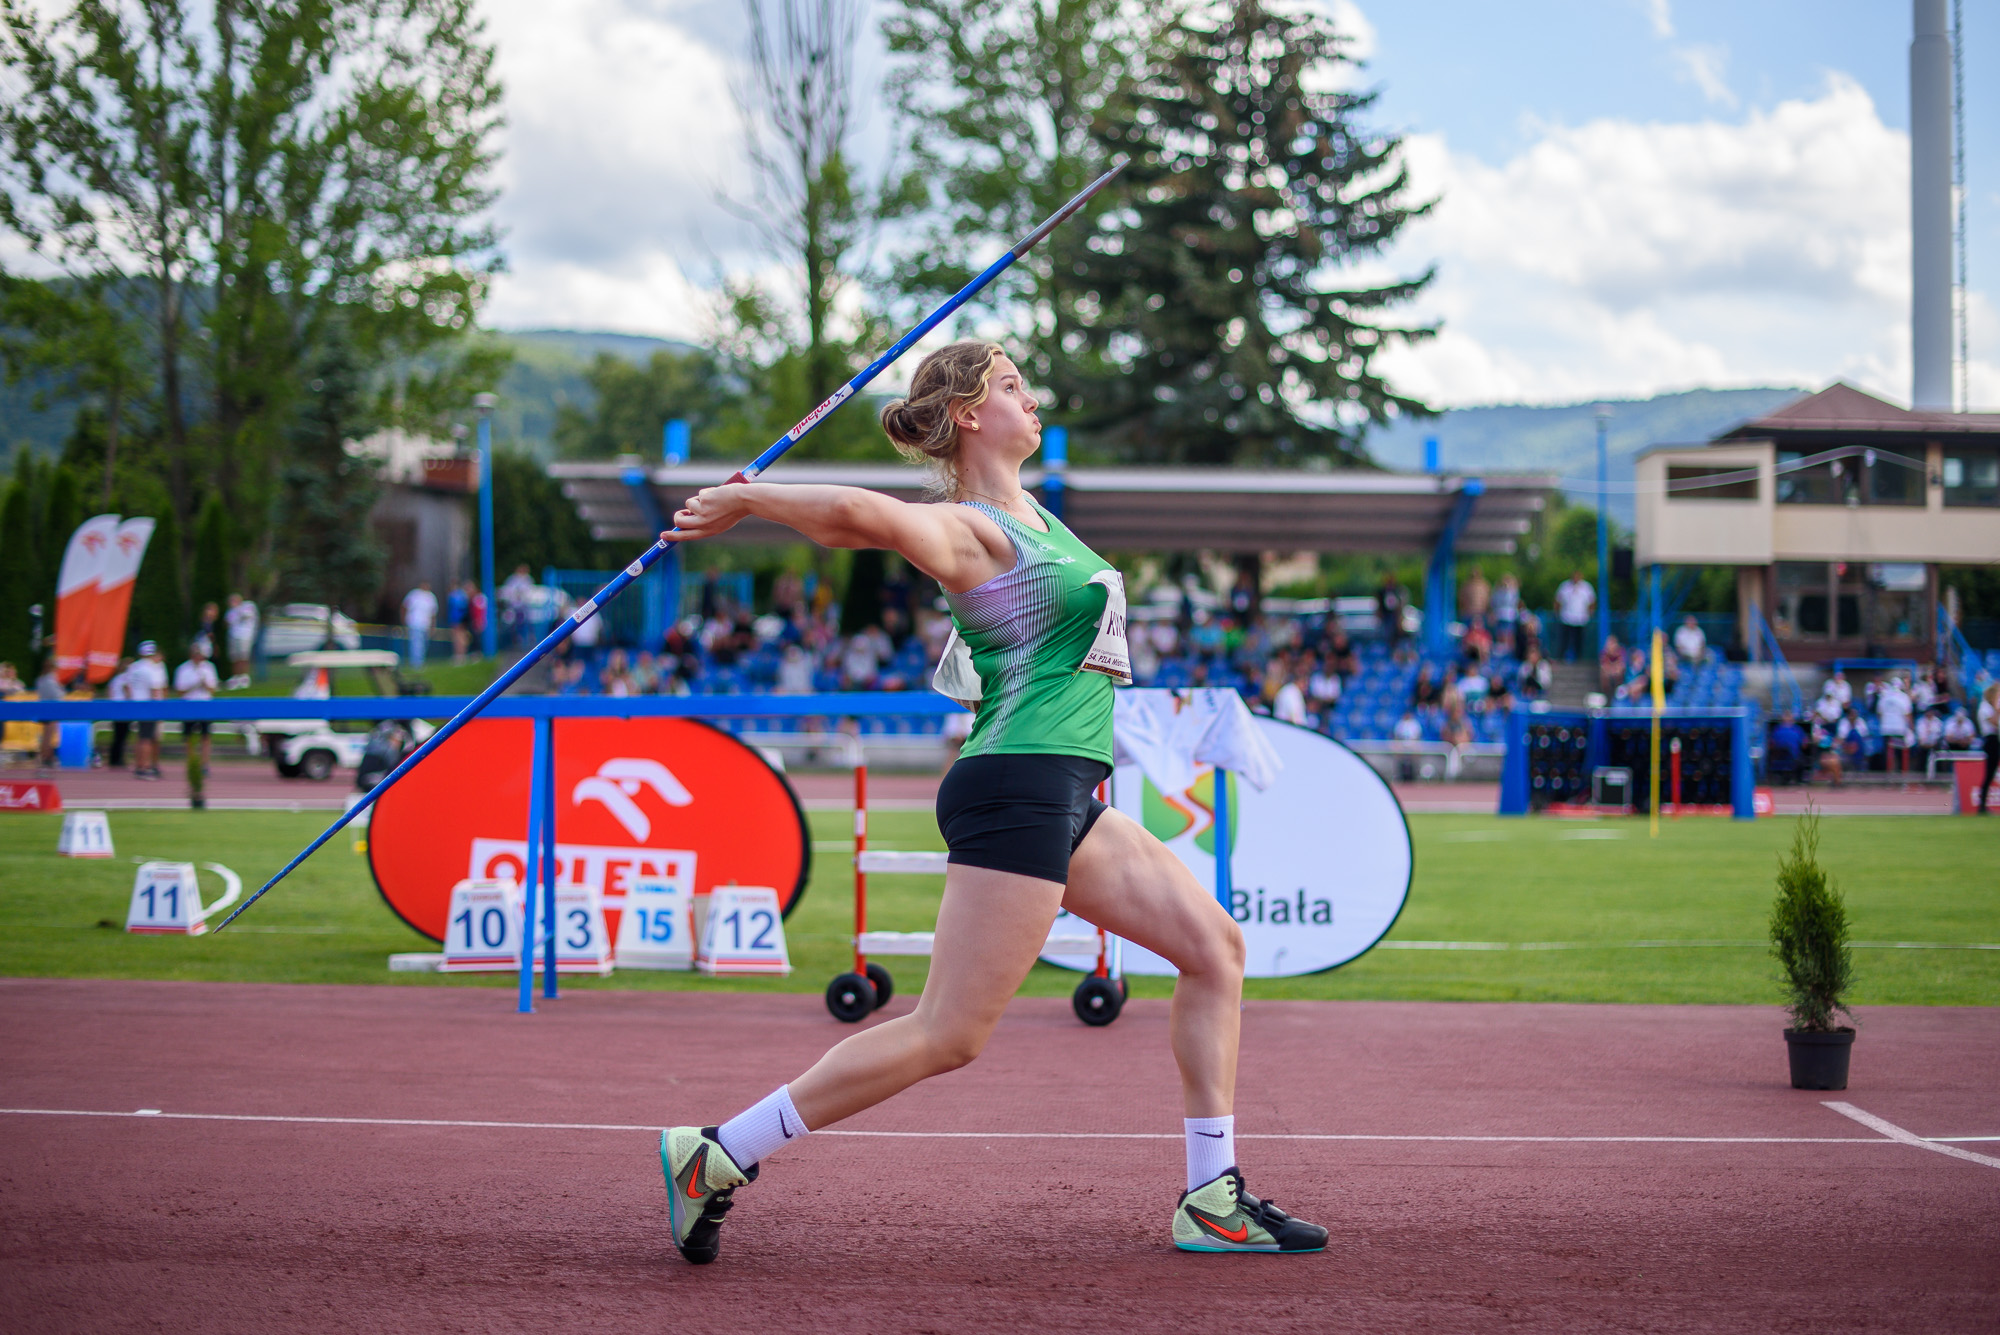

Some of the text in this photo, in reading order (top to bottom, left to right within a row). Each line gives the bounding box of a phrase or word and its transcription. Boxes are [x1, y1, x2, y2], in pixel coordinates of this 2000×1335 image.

[79, 823, 104, 846] 11
[139, 884, 178, 918] 11
[1231, 888, 1333, 925] Biała
[454, 908, 506, 949] 10
[636, 909, 673, 943] 15
[724, 908, 774, 950] 12
